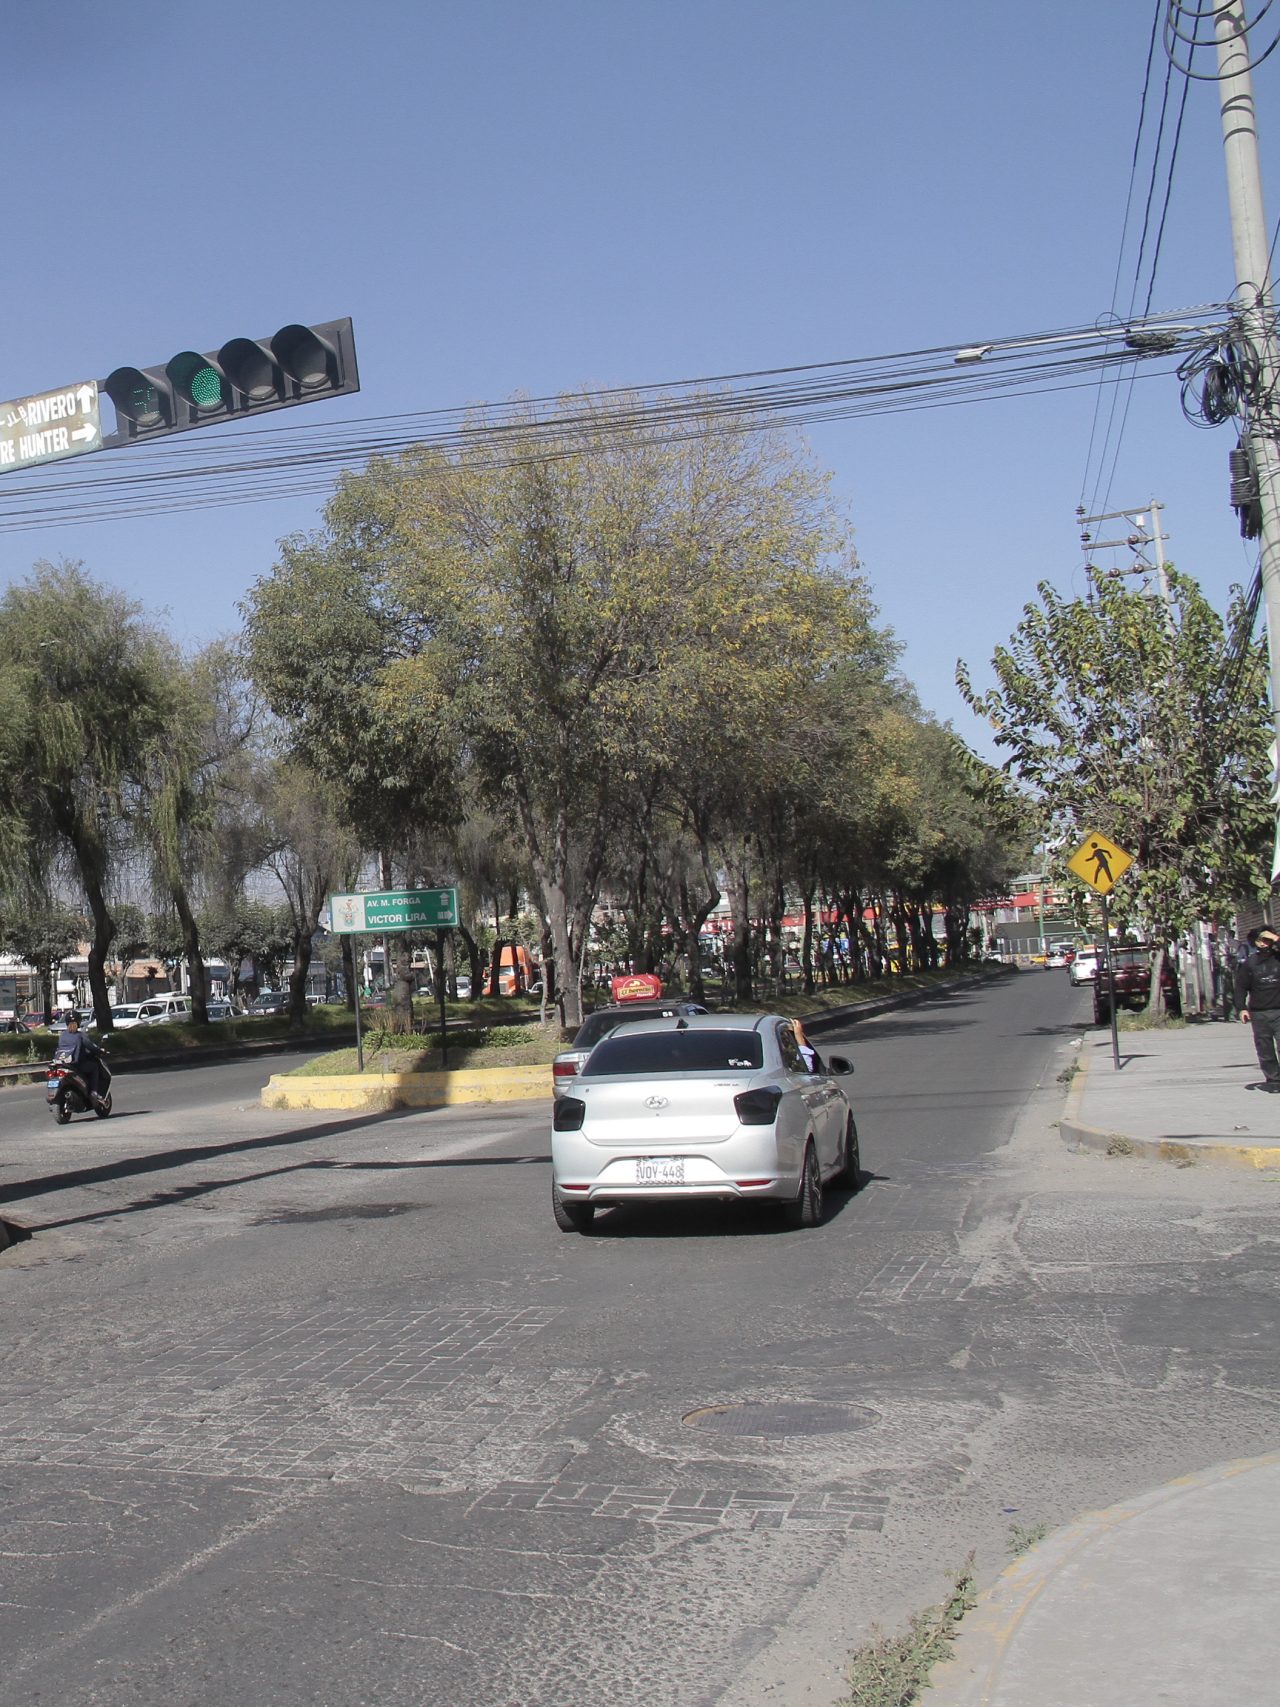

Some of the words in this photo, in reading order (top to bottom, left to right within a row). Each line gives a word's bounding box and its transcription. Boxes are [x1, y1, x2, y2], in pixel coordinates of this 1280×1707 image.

[28, 392, 76, 426] RIVERO
[20, 427, 70, 460] HUNTER
[367, 900, 379, 908] AV.
[381, 899, 390, 907] M.
[392, 897, 421, 906] FORGA
[368, 914, 402, 924] VICTOR
[405, 912, 427, 922] LIRA
